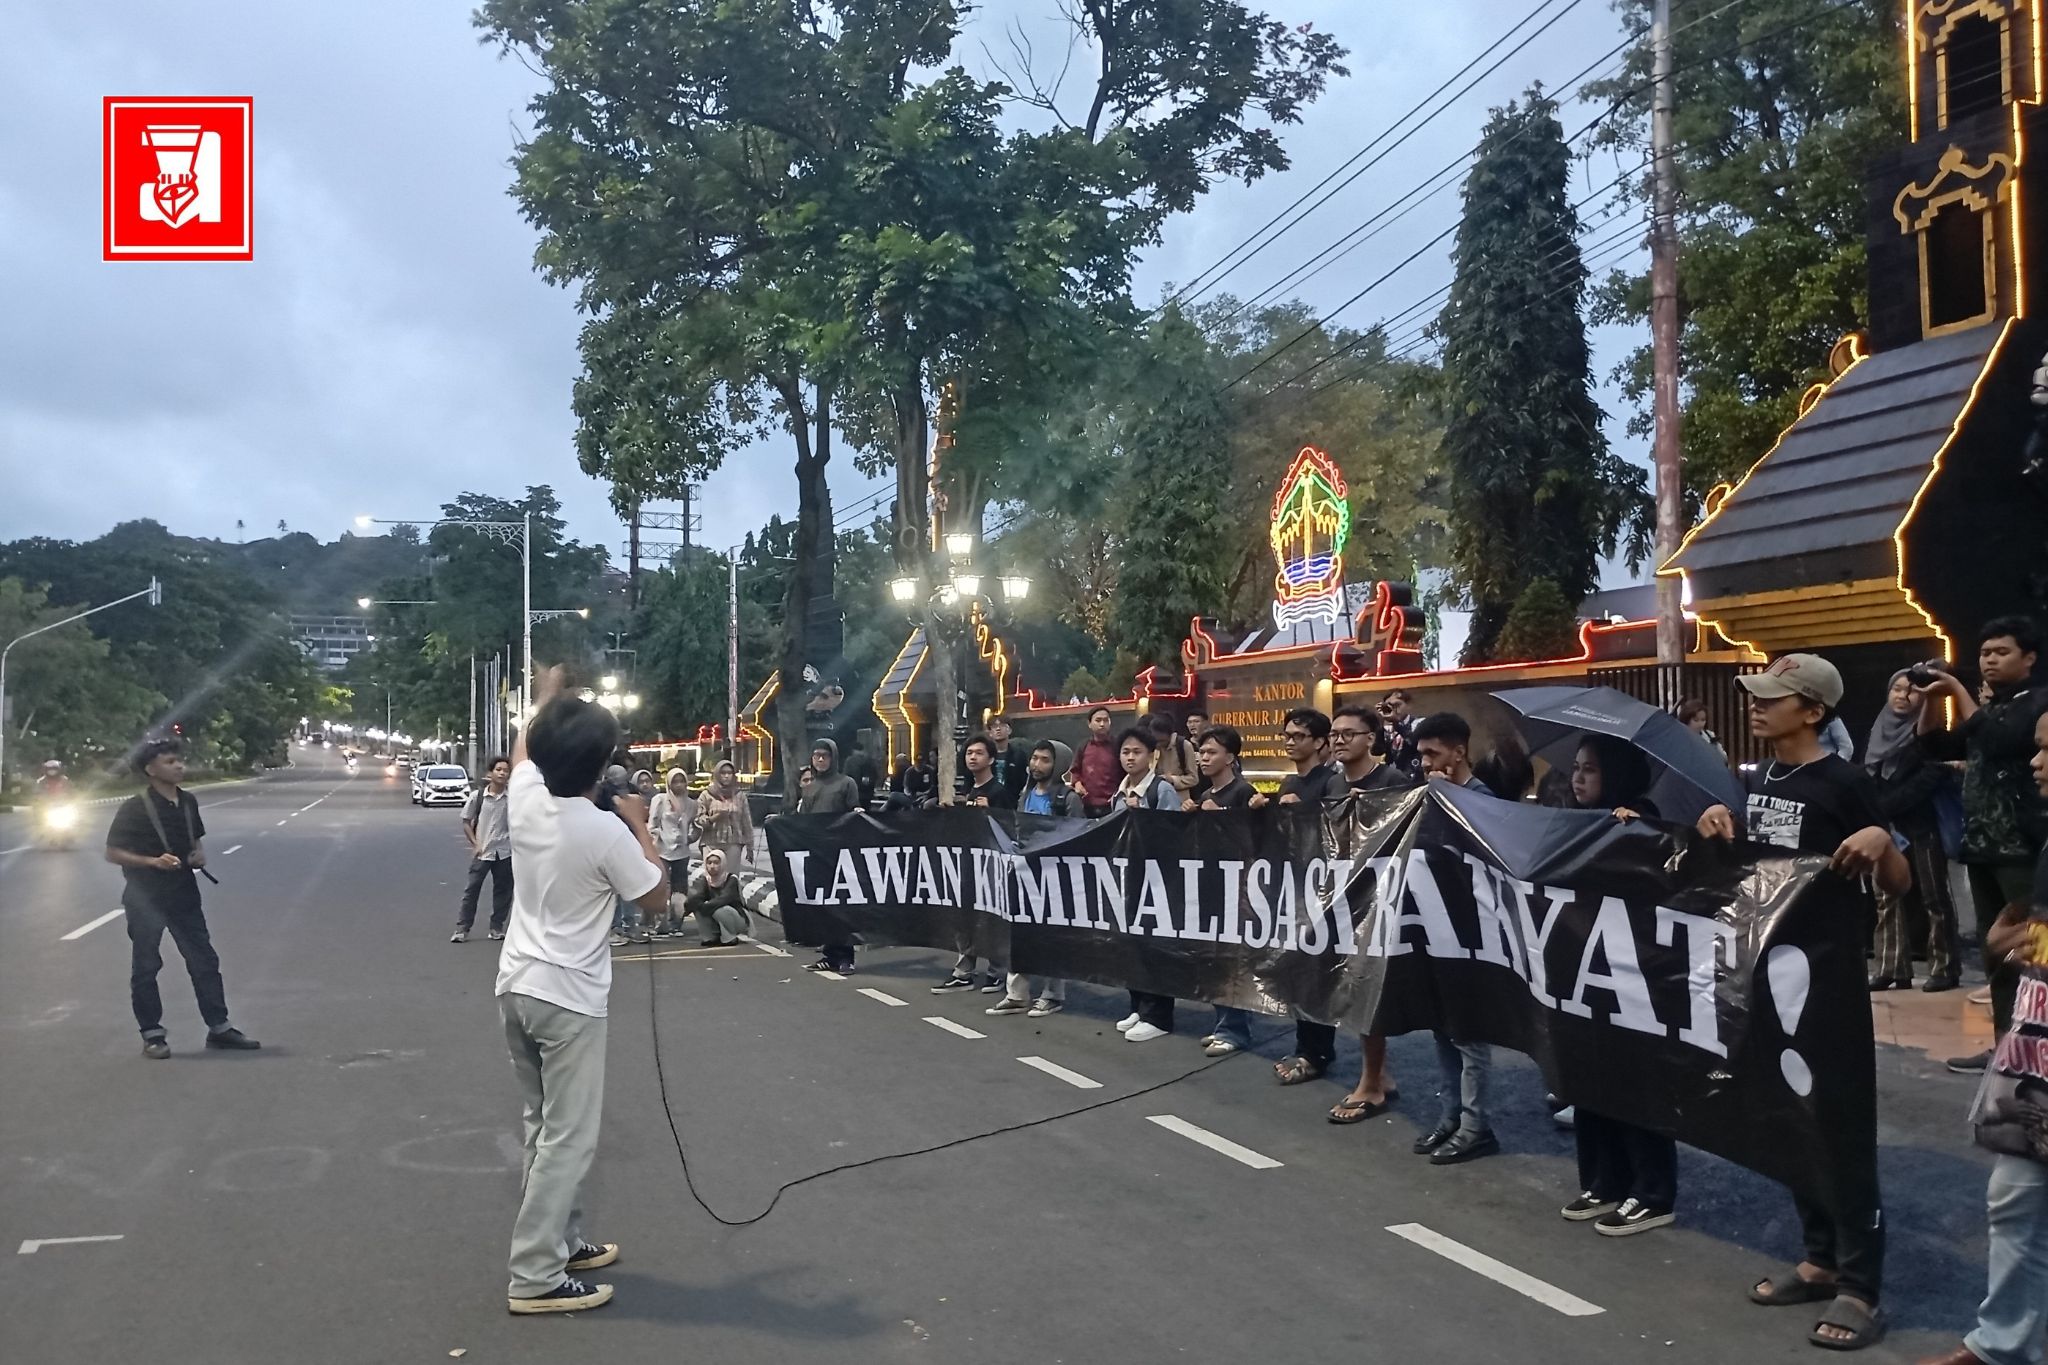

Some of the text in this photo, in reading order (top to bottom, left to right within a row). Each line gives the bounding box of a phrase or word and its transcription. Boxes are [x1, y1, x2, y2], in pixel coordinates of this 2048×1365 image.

[1255, 683, 1304, 702] KANTOR
[1769, 797, 1805, 814] TRUST
[784, 846, 962, 908] LAWAN
[970, 848, 1358, 956] KRIMINALISASI
